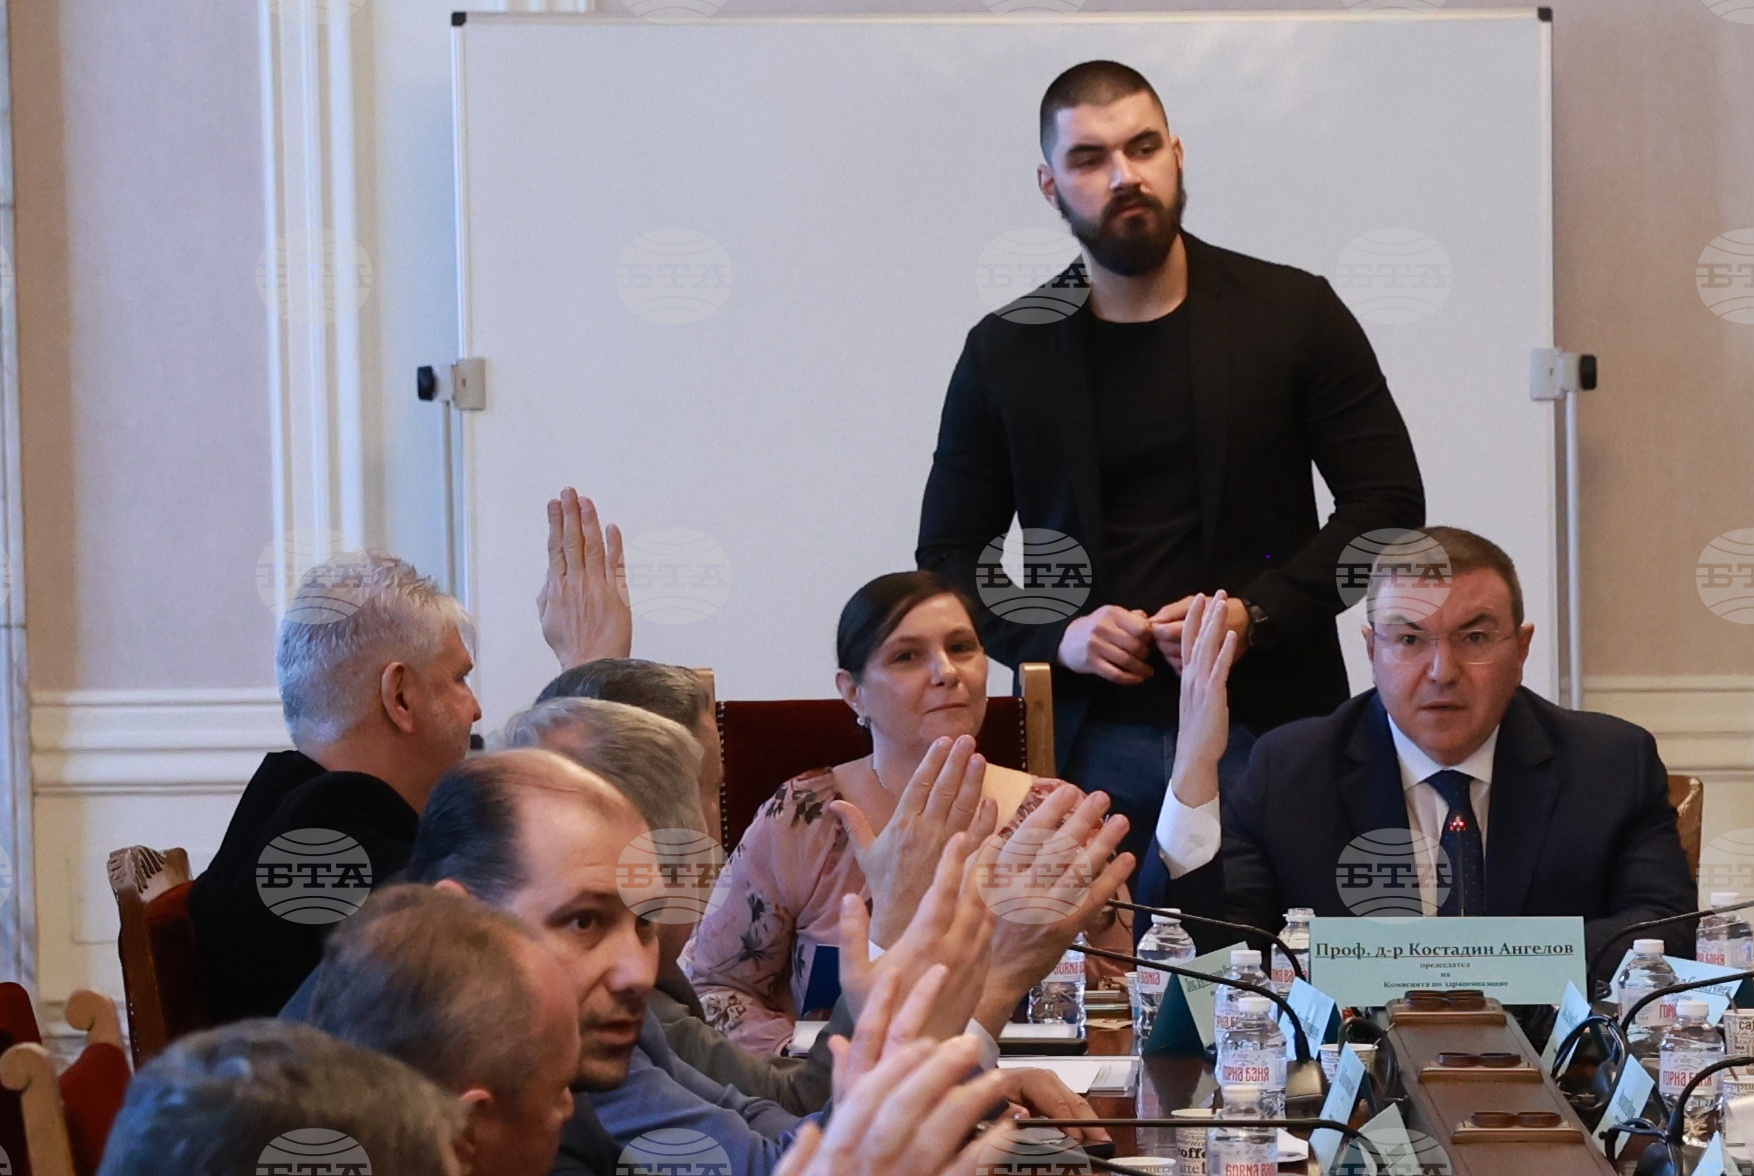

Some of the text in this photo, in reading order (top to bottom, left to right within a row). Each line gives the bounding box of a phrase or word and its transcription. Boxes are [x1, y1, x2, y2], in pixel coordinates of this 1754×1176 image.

[1315, 942, 1574, 960] Проф. д-р Костадин Ангелов
[1245, 1066, 1270, 1082] БАНЯ
